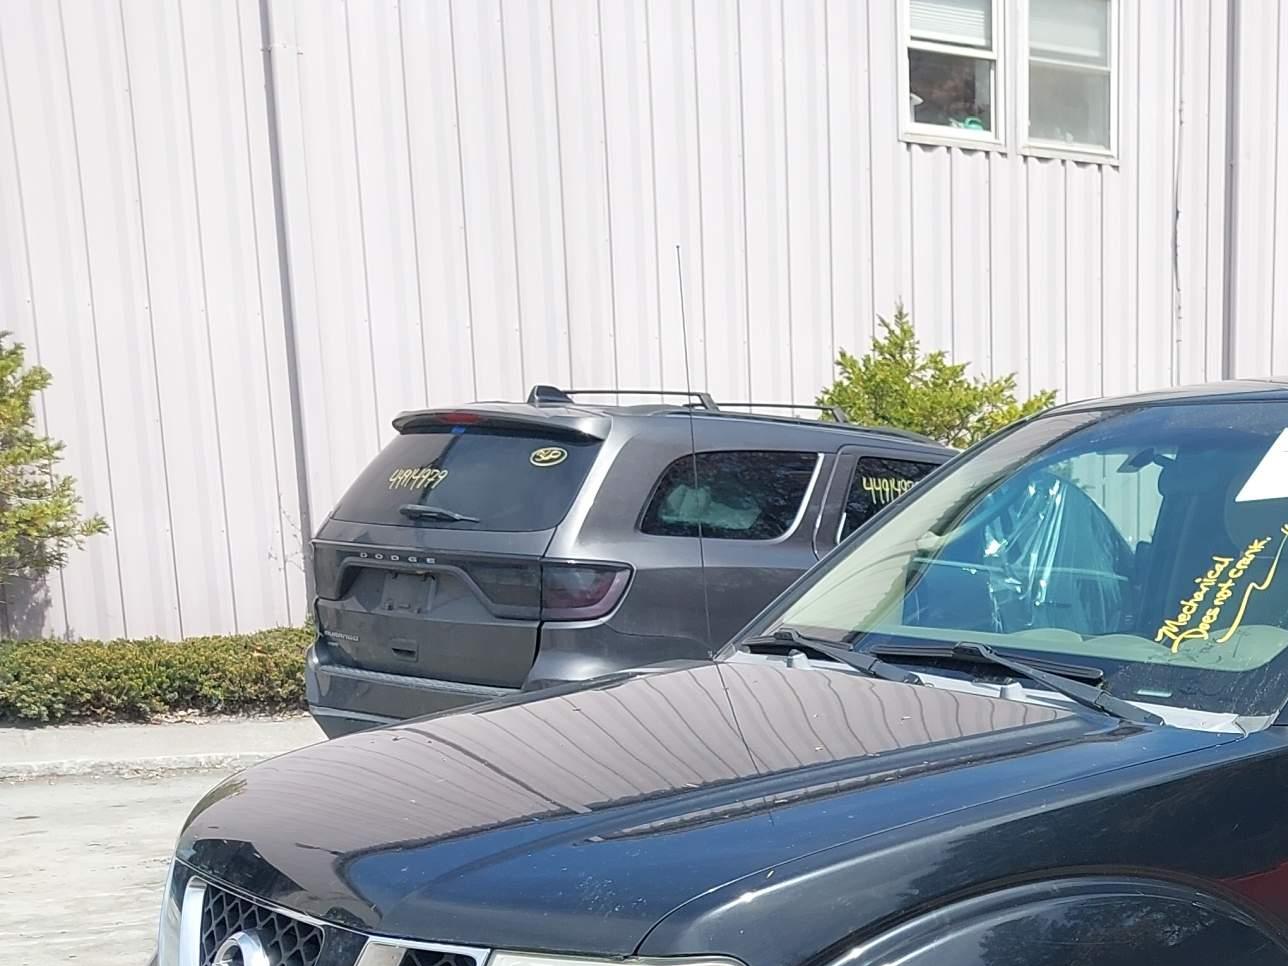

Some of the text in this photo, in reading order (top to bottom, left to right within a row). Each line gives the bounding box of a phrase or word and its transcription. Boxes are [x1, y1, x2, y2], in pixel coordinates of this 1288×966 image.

[862, 475, 920, 504] 449149
[359, 552, 436, 564] DODGE
[1155, 556, 1234, 641] Mechanical
[1171, 606, 1221, 653] Does
[1213, 579, 1235, 606] not
